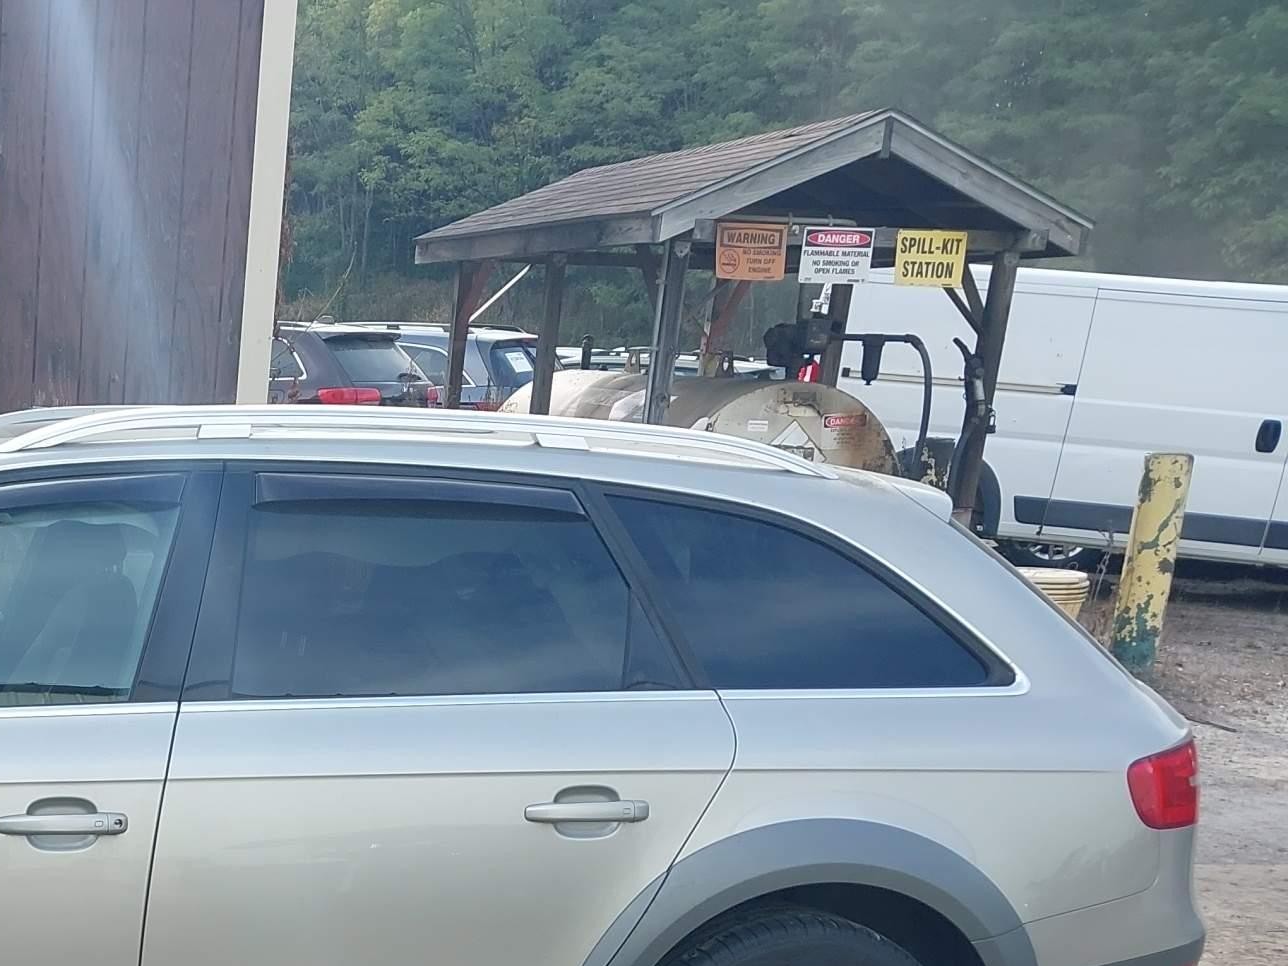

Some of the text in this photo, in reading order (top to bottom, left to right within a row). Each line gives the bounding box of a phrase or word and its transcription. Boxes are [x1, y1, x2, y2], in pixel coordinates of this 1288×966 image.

[727, 231, 776, 244] WARNING
[817, 234, 860, 244] DANGER
[900, 236, 963, 255] SPILL-KIT
[804, 249, 870, 258] FLAMMABLE MATERIAL
[902, 260, 954, 279] STATION
